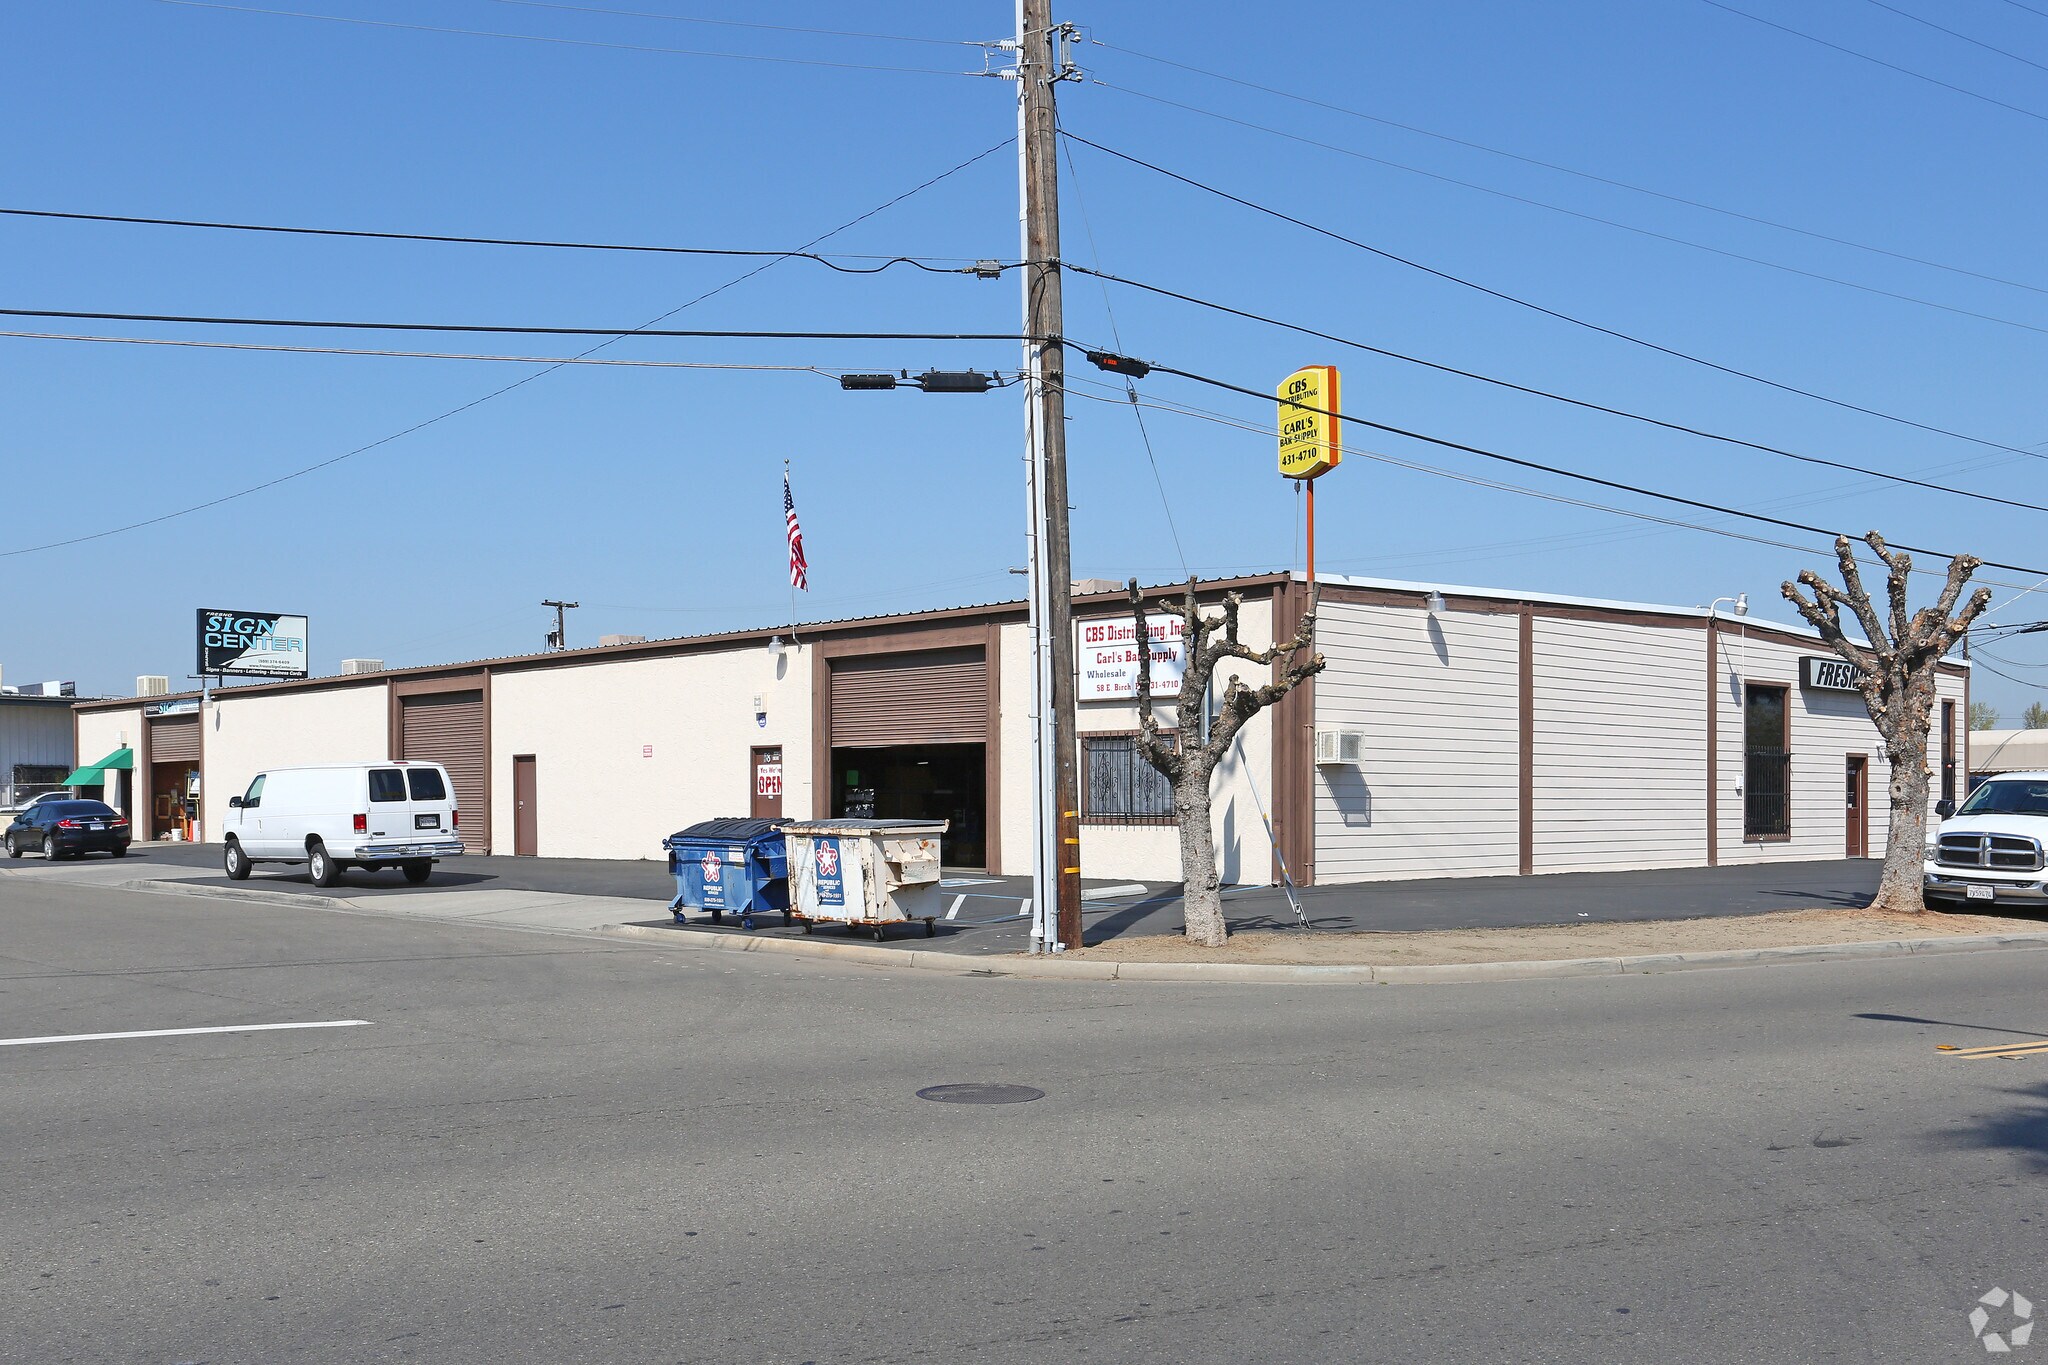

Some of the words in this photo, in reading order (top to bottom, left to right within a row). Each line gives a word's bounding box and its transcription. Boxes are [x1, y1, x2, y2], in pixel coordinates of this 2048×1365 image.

[1289, 378, 1307, 395] CBS
[1279, 388, 1318, 407] TRIBUTING
[1284, 416, 1313, 435] CARL'S
[1294, 428, 1318, 443] SUPPLY
[1282, 447, 1317, 466] 431-4710
[205, 616, 279, 635] SIGN
[1086, 625, 1105, 642] CBS
[204, 632, 303, 652] CENTER
[1097, 651, 1122, 664] Carl's
[1087, 669, 1126, 678] Wholesale
[1816, 662, 1862, 689] FRESN
[1096, 684, 1104, 692] 58
[1114, 683, 1131, 691] Birch
[1150, 680, 1179, 689] 31-4710
[758, 775, 782, 793] OPEN
